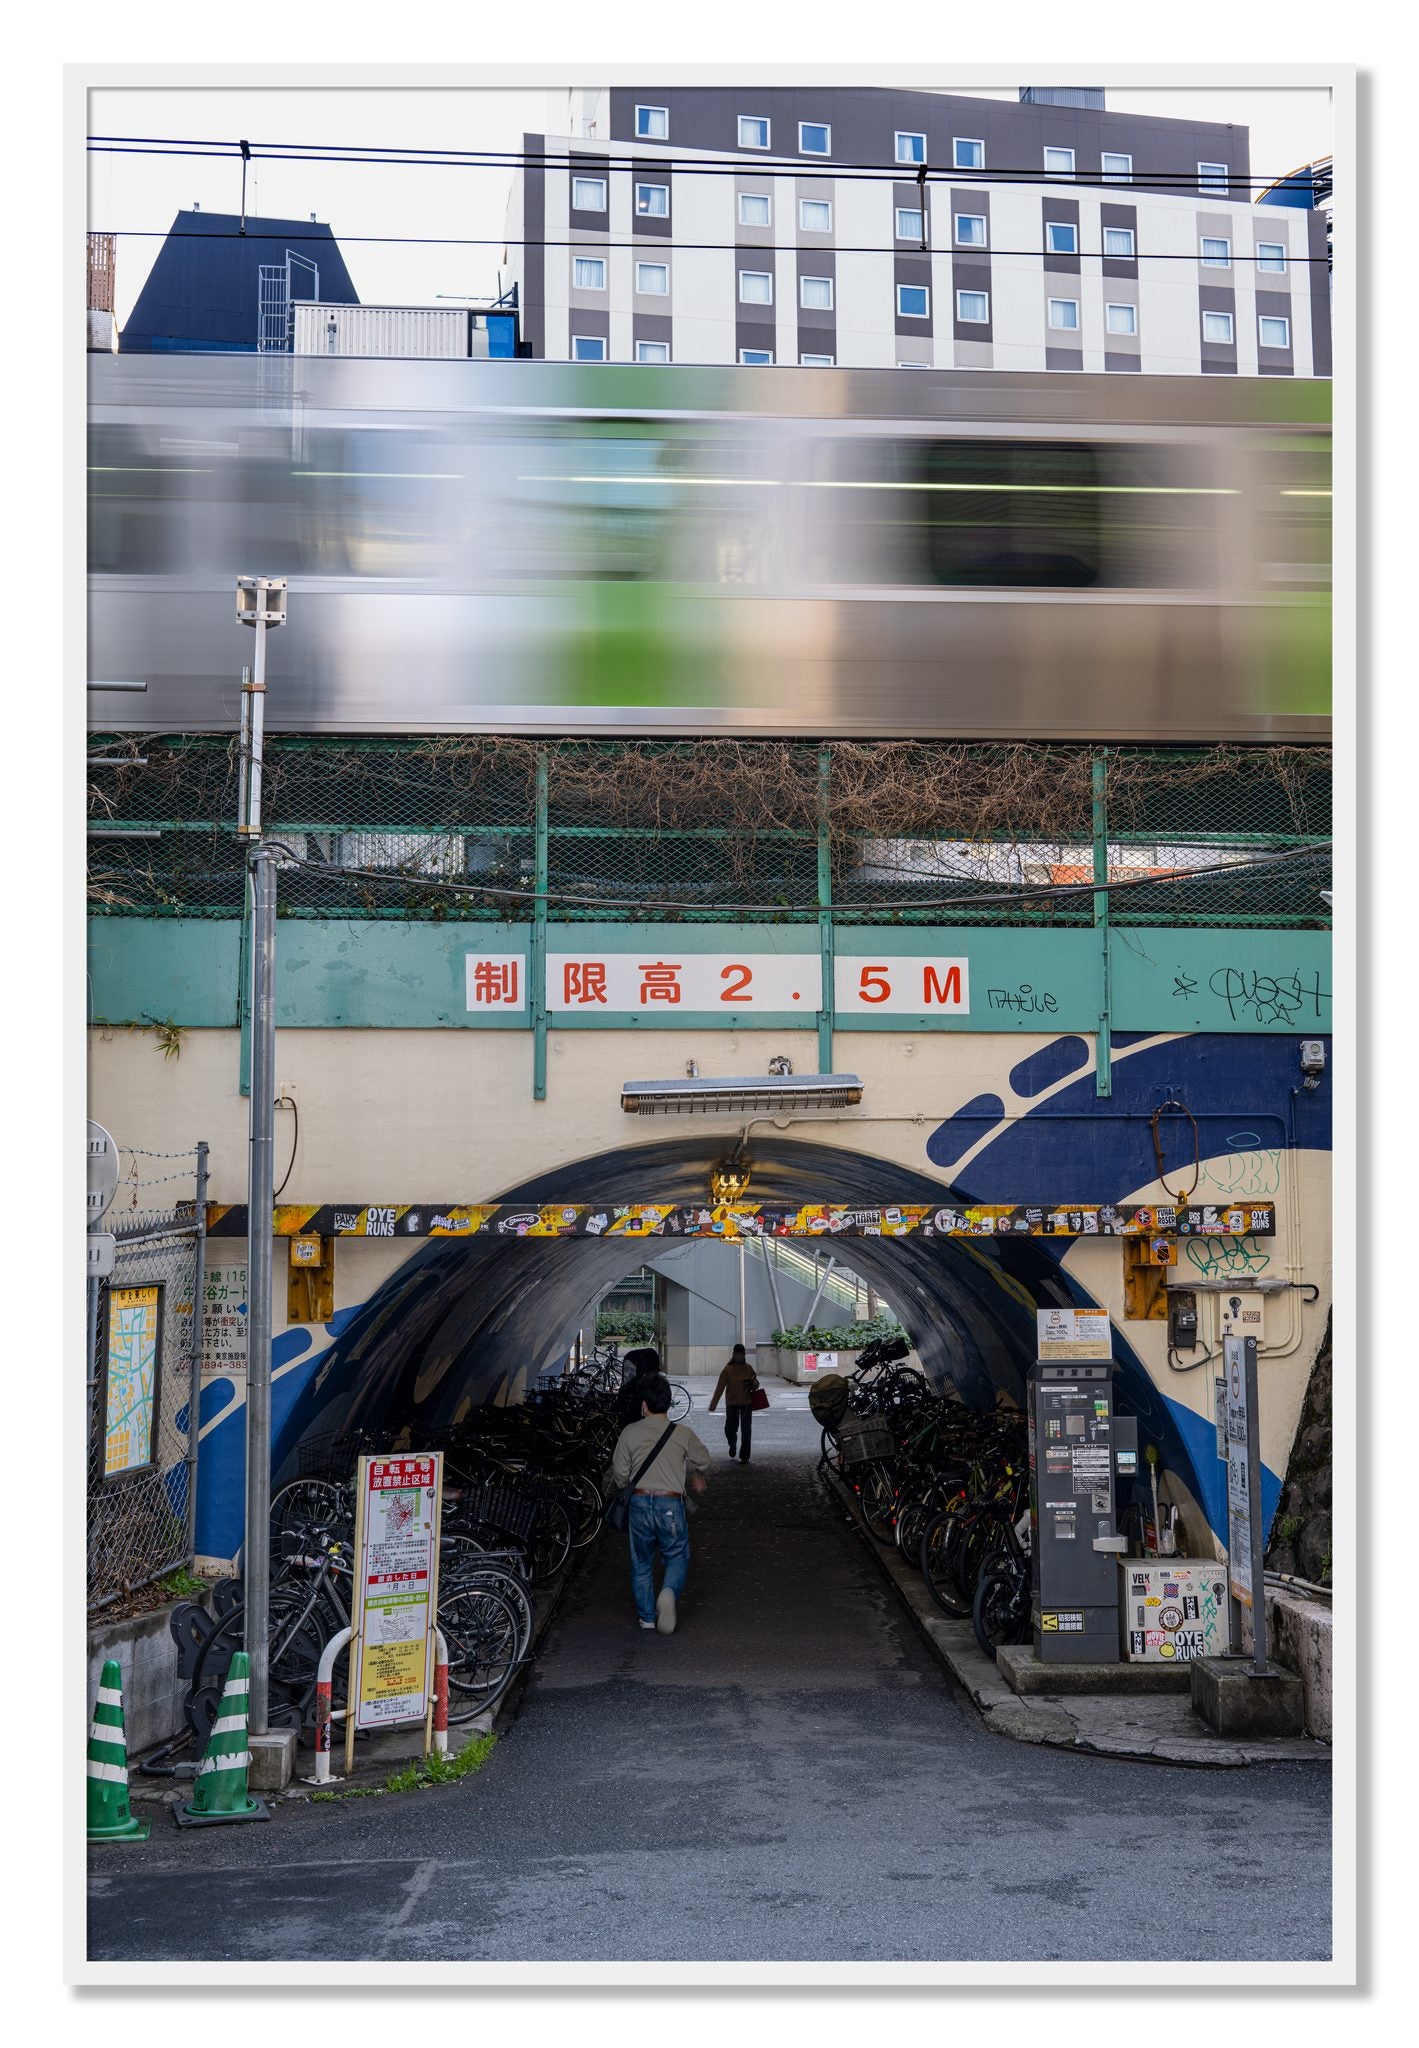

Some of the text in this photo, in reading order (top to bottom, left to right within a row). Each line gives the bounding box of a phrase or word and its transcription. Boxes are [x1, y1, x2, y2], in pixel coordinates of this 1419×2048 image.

[367, 1208, 396, 1222] OYE
[1251, 1210, 1269, 1220] OYE
[366, 1222, 395, 1237] RUNS
[1251, 1219, 1270, 1229] RUNS
[373, 1473, 431, 1488] 放置禁止区域
[1058, 1613, 1083, 1622] 防犯検知
[1058, 1622, 1083, 1631] 装置搭載
[1175, 1632, 1203, 1646] OYE
[1176, 1645, 1204, 1660] RUNS
